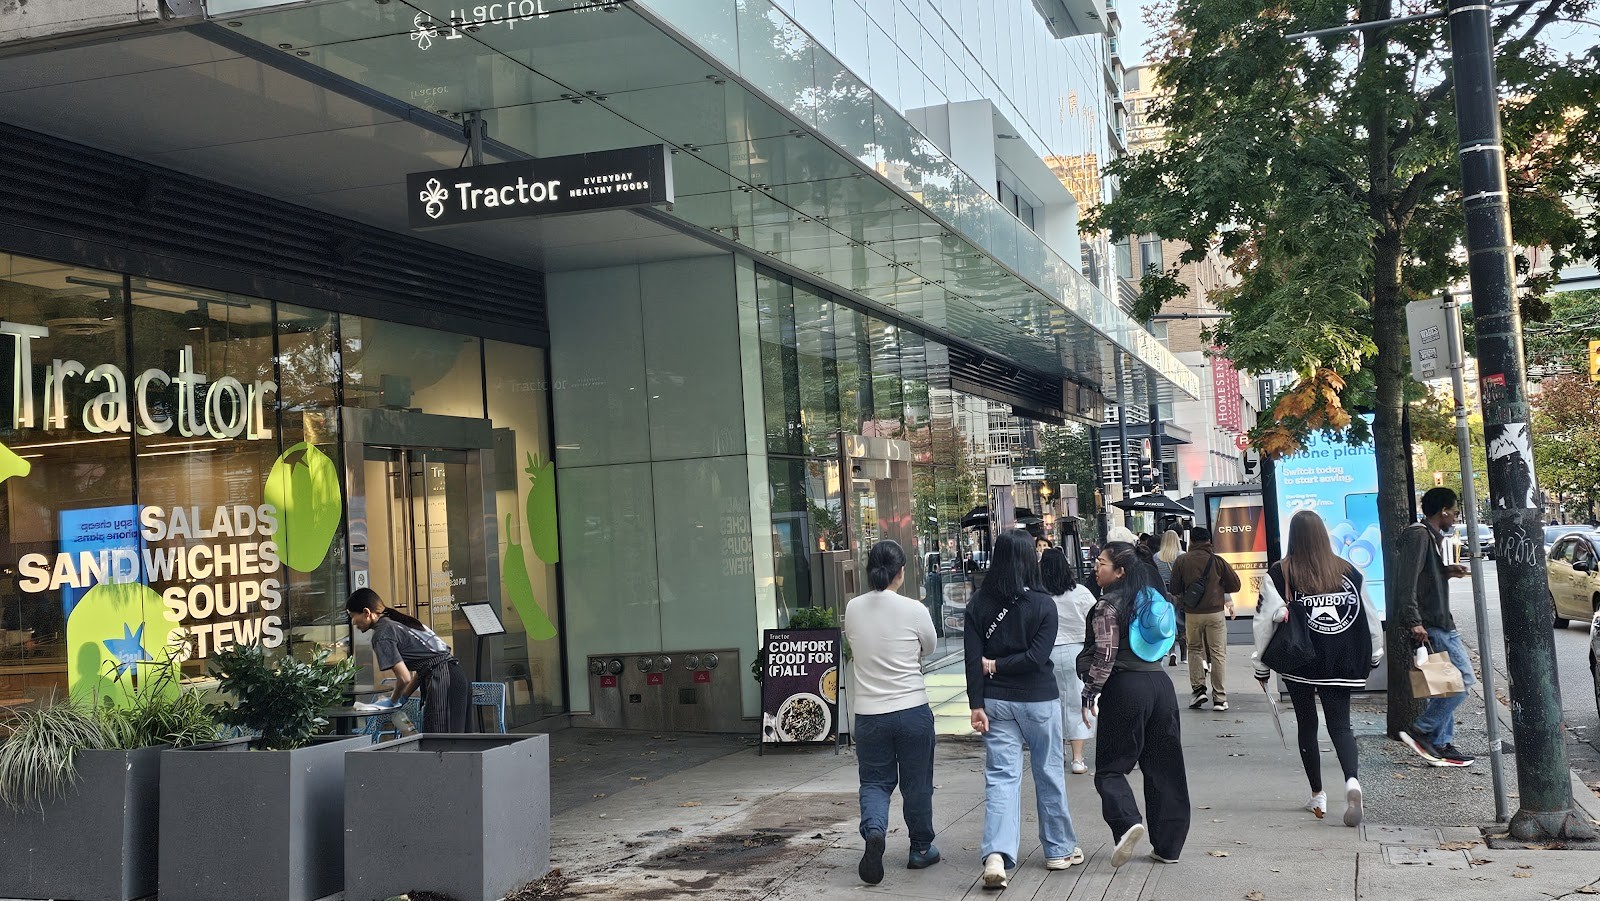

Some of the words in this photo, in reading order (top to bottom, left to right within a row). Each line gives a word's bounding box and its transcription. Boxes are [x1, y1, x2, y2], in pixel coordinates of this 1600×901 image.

[584, 172, 633, 185] EVERYDAY
[455, 175, 562, 211] Tractor
[570, 184, 613, 197] HEALTHY
[616, 181, 649, 193] FOODS
[0, 322, 279, 441] Tractor
[1316, 466, 1344, 475] today
[140, 504, 279, 542] SALADS
[18, 541, 280, 593] SANDWICHES
[163, 578, 282, 623] SOUPS
[1303, 593, 1357, 607] OWBOYS
[166, 615, 284, 663] STEWS
[768, 640, 834, 653] COMFORT
[768, 653, 806, 664] FOOD
[808, 652, 834, 664] FOR
[768, 665, 808, 677] (F)ALL
